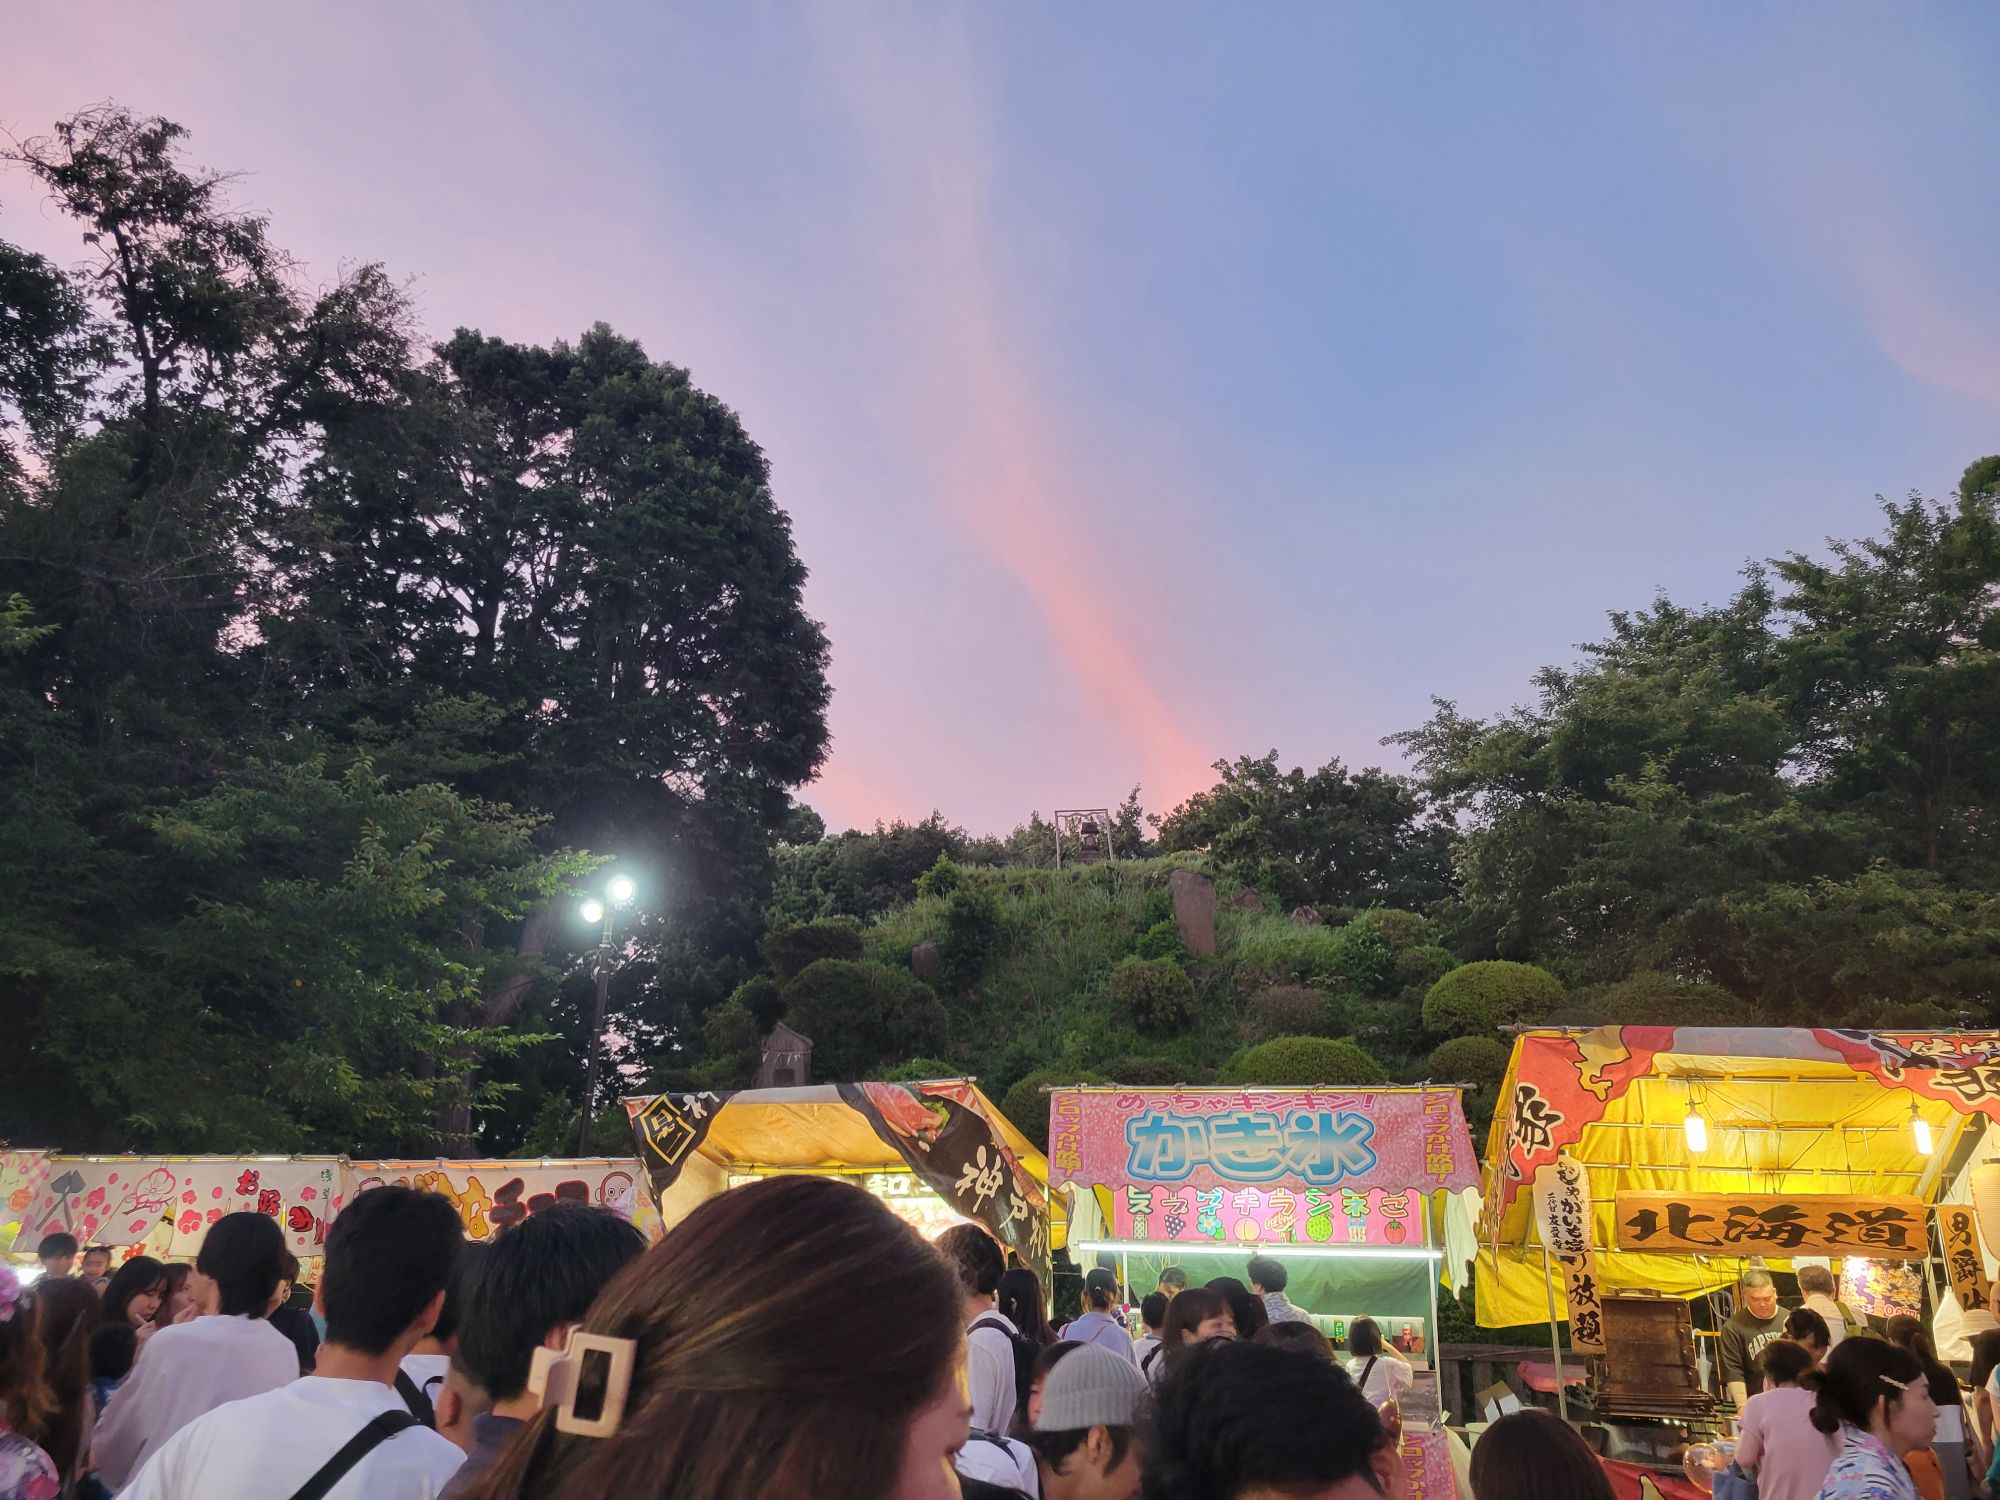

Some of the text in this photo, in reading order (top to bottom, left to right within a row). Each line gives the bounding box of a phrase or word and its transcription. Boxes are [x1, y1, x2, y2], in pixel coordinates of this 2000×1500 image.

[1115, 1093, 1376, 1110] めっちゃキンキン!
[1127, 1109, 1378, 1186] かき氷
[1624, 1201, 1919, 1252] 北海道
